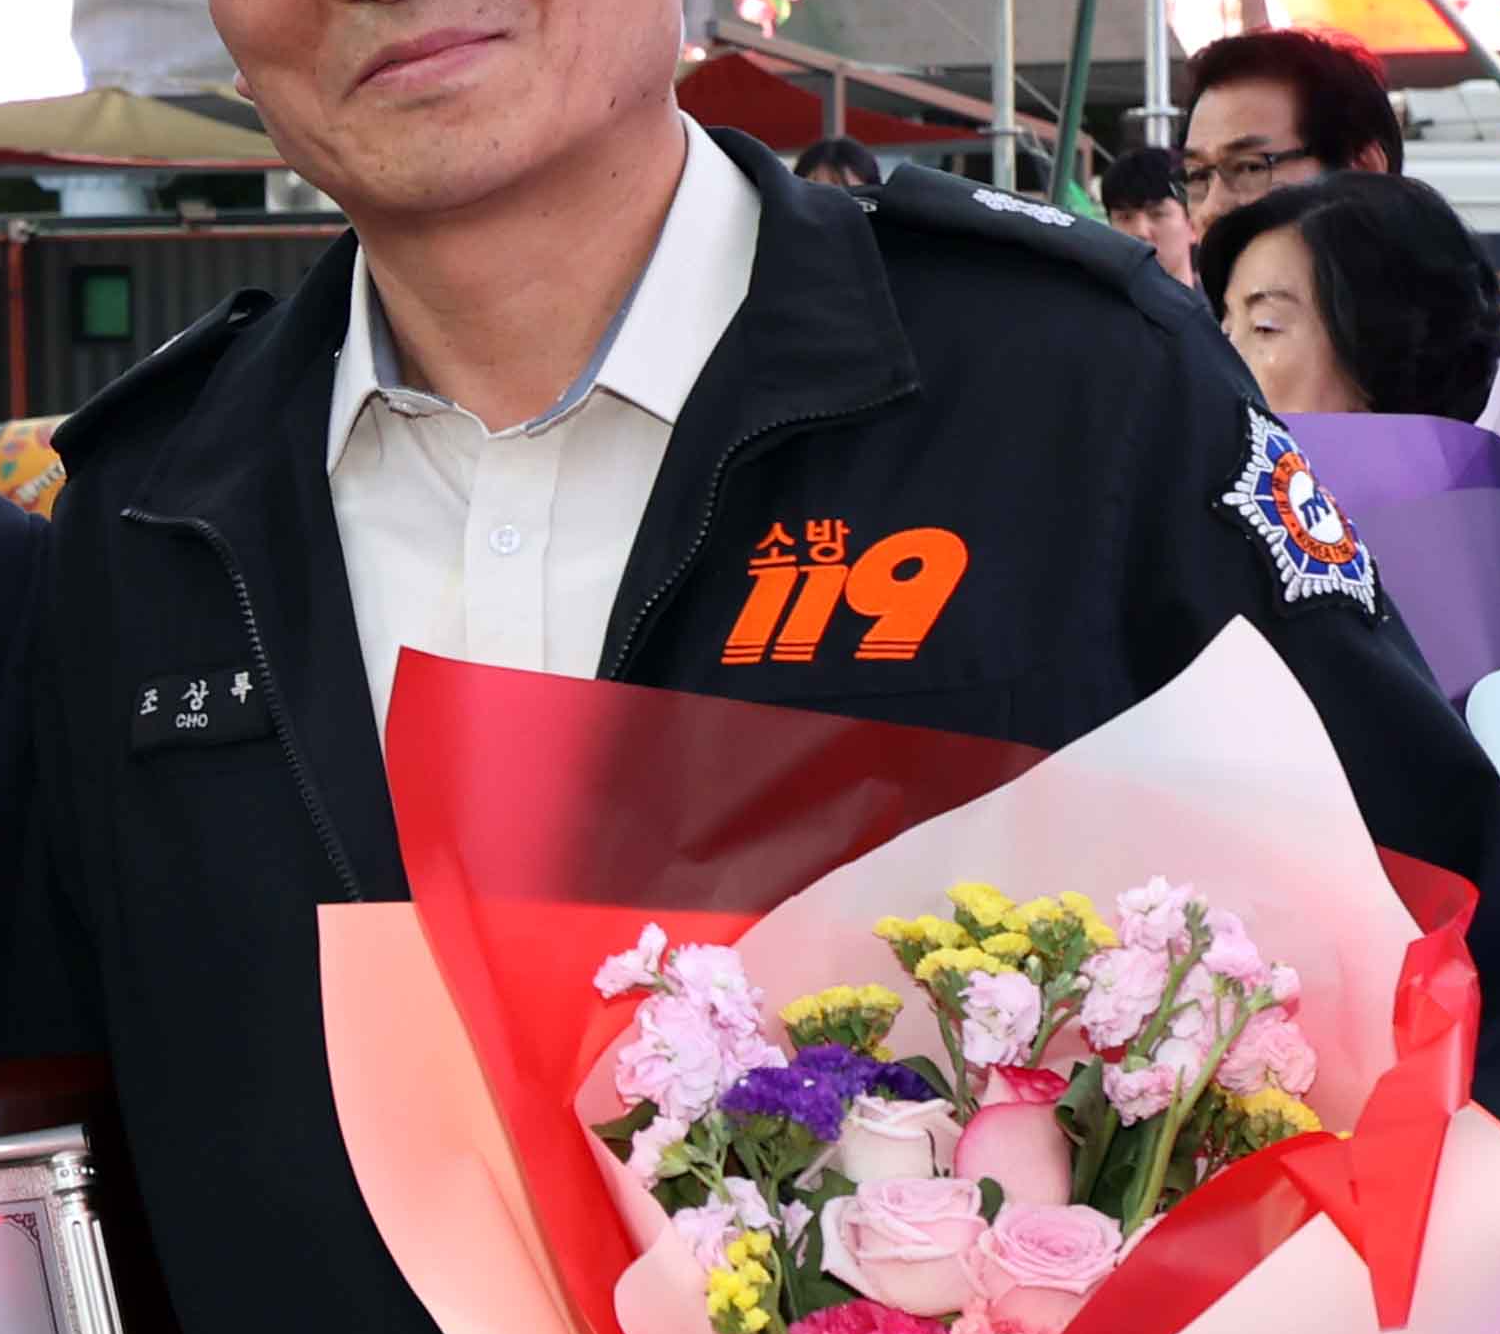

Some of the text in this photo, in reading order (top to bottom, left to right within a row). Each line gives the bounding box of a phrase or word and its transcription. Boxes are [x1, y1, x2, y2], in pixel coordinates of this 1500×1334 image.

[749, 519, 850, 566] 소방
[720, 527, 969, 664] 119
[175, 713, 209, 728] CHO
